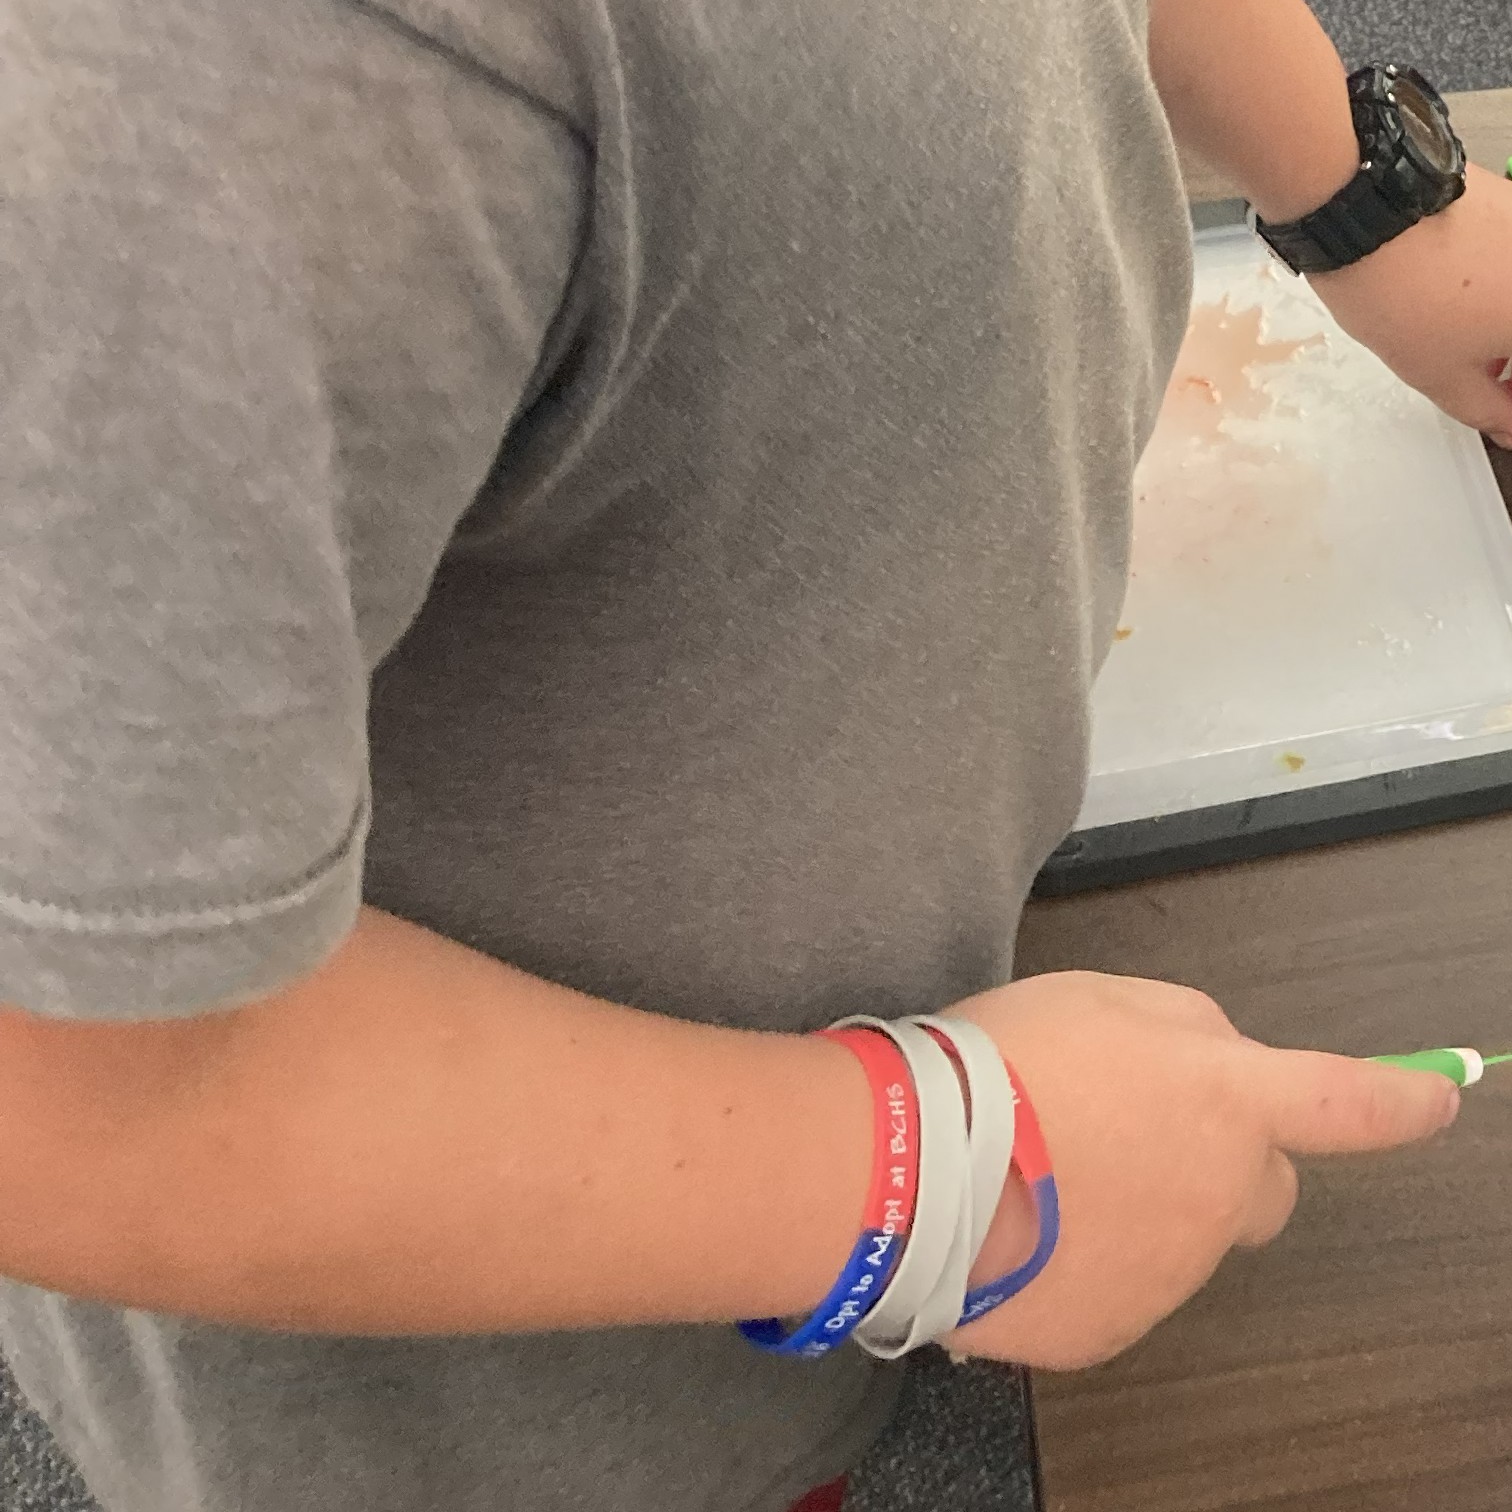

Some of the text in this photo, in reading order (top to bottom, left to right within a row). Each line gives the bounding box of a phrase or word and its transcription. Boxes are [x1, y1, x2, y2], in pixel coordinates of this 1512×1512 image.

[825, 1082, 909, 1331] Opt to Adopt at BCHS
